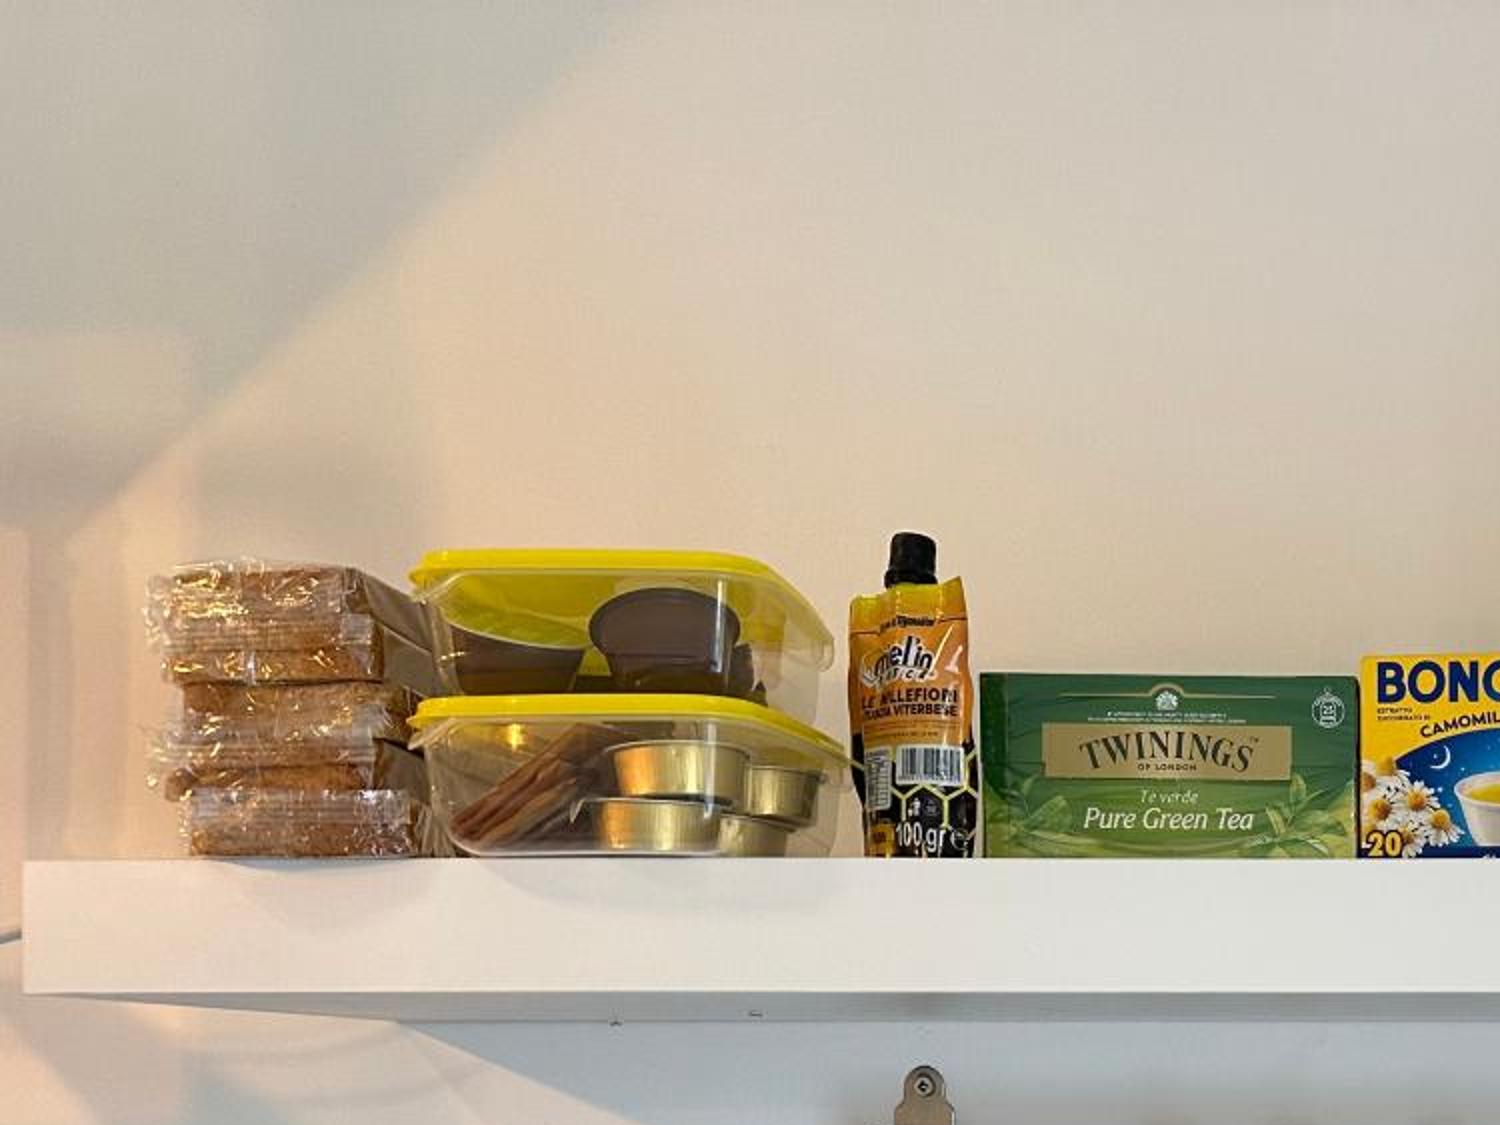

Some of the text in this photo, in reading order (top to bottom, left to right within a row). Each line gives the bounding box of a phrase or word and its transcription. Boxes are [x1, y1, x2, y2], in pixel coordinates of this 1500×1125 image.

[1079, 730, 1256, 774] TWININGS
[1138, 764, 1197, 772] OF LONDON
[1083, 807, 1255, 830] Pure Green Tea
[1367, 831, 1404, 857] 20
